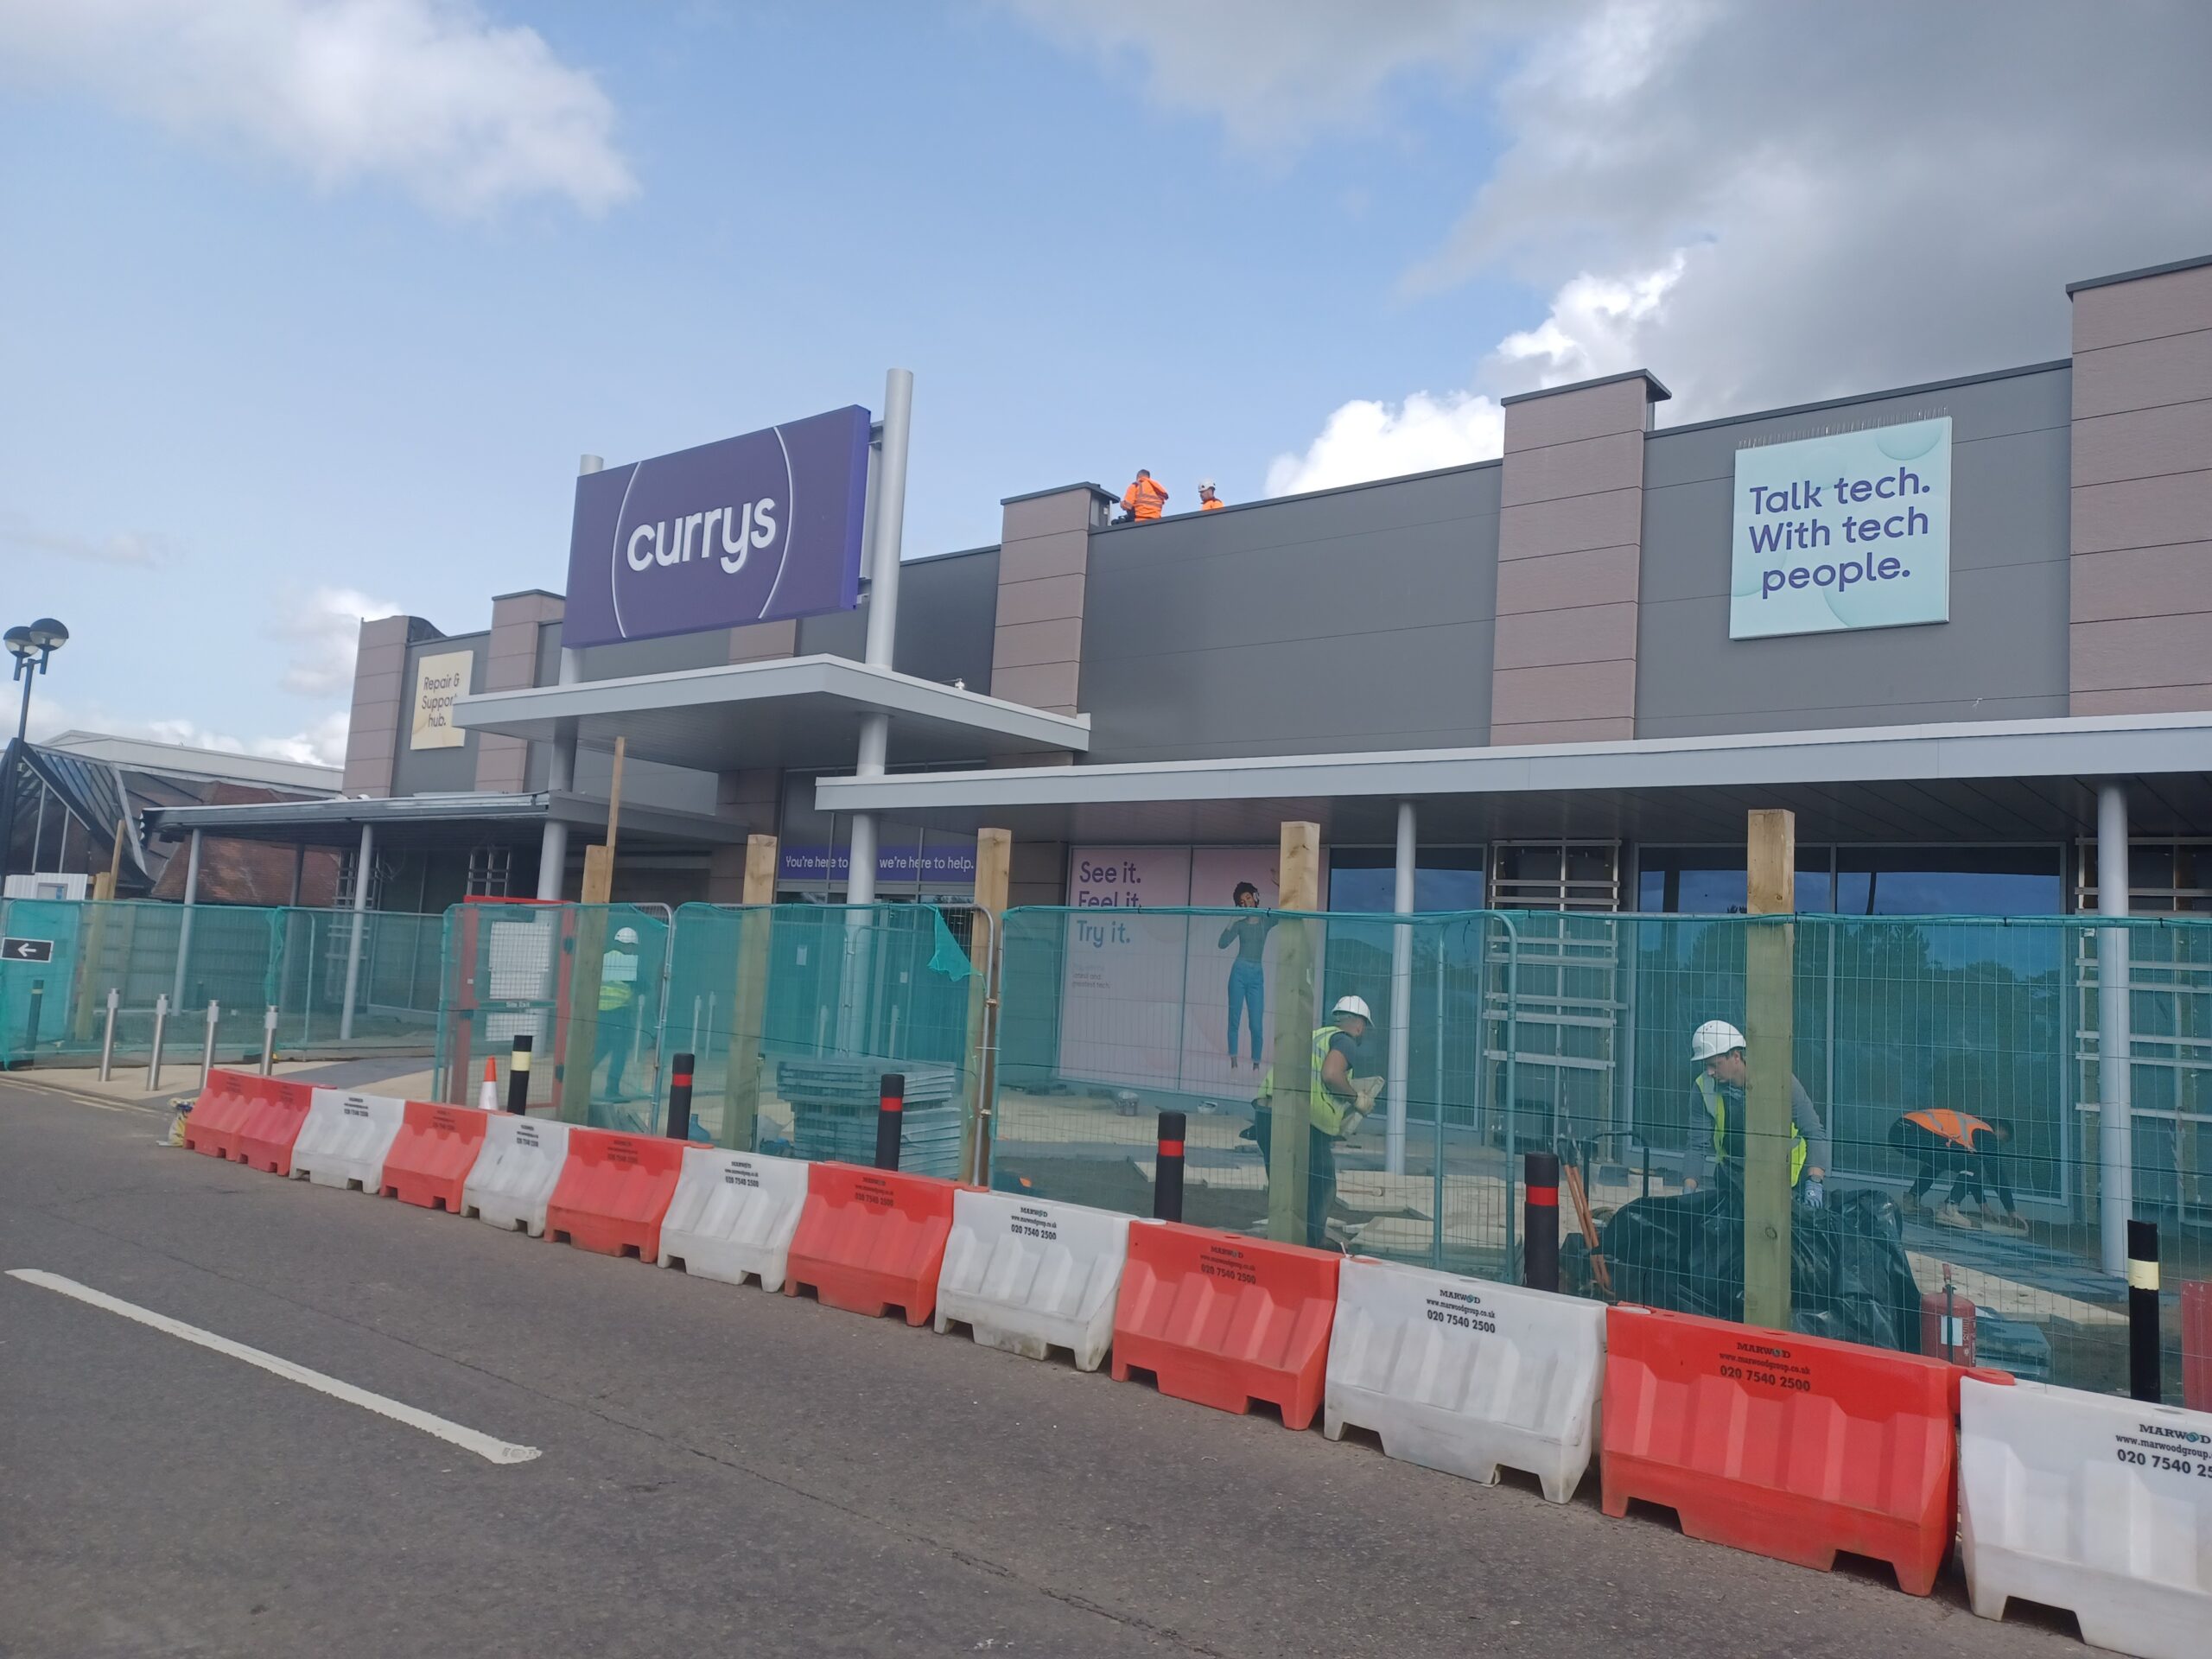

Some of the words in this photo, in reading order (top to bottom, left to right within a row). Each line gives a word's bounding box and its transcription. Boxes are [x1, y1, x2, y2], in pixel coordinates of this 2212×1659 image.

[1749, 480, 1822, 515] Talk
[1834, 467, 1930, 504] tech.
[627, 498, 776, 574] currys
[1749, 518, 1830, 553] With
[1842, 506, 1929, 543] tech
[1763, 552, 1910, 599] people.
[423, 674, 451, 692] Repair
[454, 672, 460, 687] &
[421, 694, 457, 712] Suppor
[428, 713, 446, 727] hub.
[785, 855, 813, 868] You're
[838, 856, 849, 868] to
[880, 856, 906, 868] we're
[934, 856, 945, 869] to
[948, 856, 974, 872] help.
[1079, 861, 1117, 883] See
[1123, 861, 1141, 883] it.
[1079, 891, 1118, 907] Feel
[1126, 891, 1141, 907] it
[1077, 920, 1104, 948] Try
[1111, 921, 1130, 943] it.
[1427, 1309, 1444, 1322] 020
[1446, 1313, 1470, 1328] 7540
[1472, 1319, 1496, 1333] 2500
[1720, 1365, 1742, 1379] 020
[1746, 1370, 1776, 1386] 7540
[1780, 1376, 1811, 1392] 2500
[2115, 1434, 2212, 1460] www.marwoodgroup.
[2117, 1449, 2146, 1465] 020
[2152, 1455, 2191, 1474] 7540
